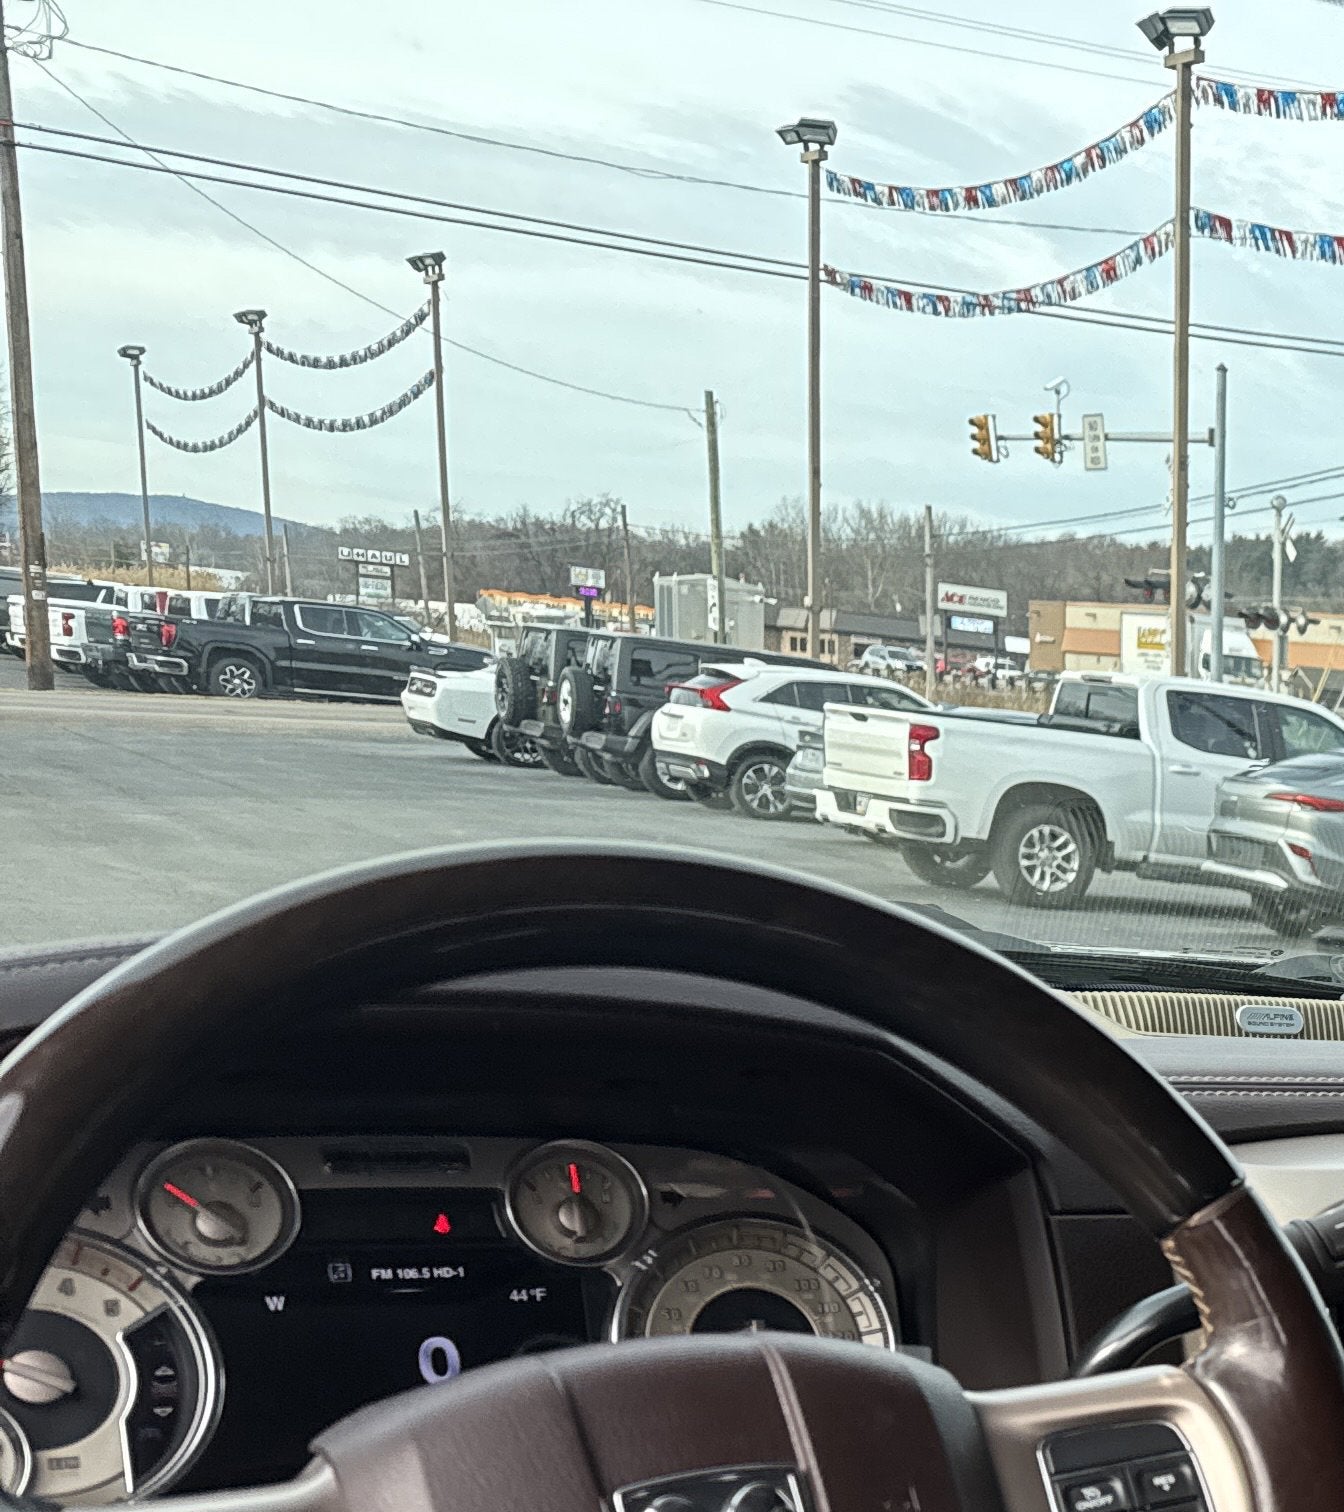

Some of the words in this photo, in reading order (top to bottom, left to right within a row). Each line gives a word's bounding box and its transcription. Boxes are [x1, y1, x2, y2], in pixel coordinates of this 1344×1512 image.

[370, 1268, 394, 1281] FM
[395, 1266, 431, 1280] 106.5
[264, 1295, 286, 1312] W
[417, 1335, 462, 1386] 0
